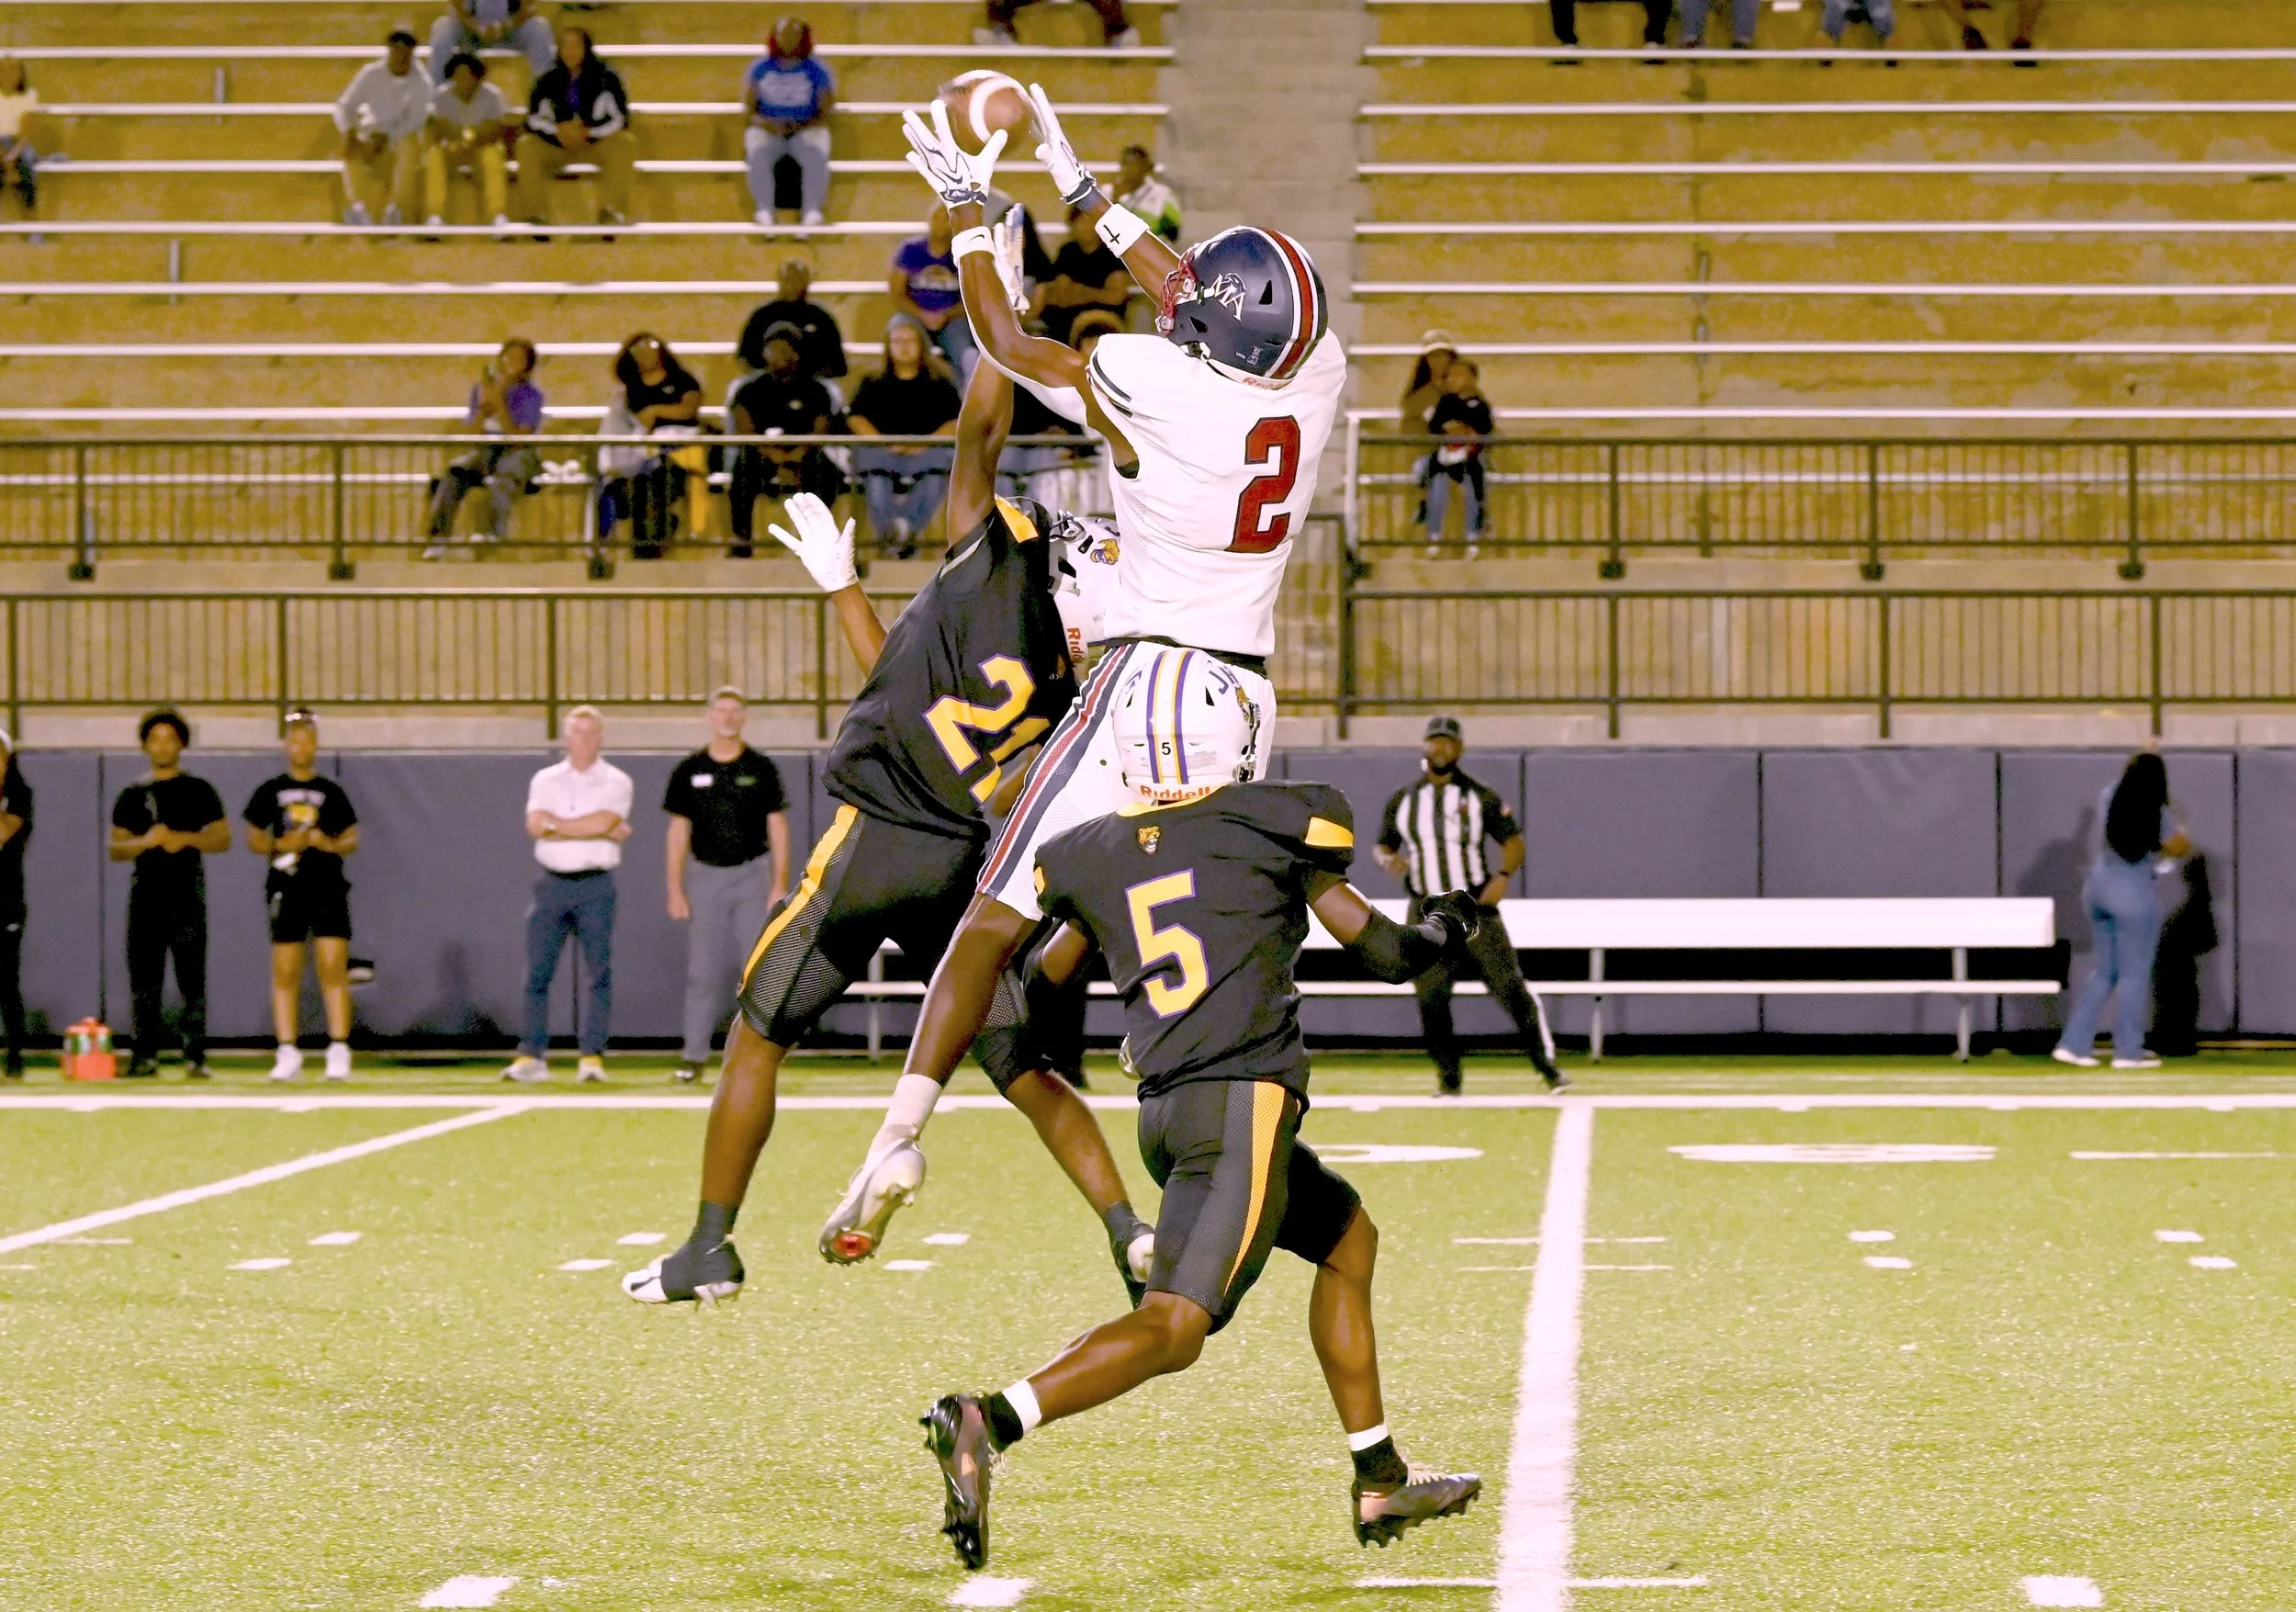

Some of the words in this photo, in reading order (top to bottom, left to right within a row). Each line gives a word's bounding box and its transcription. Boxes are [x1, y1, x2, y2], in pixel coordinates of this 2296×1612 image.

[1224, 414, 1301, 554] 2
[1162, 742, 1172, 756] 5
[1140, 784, 1210, 801] Riddell
[1124, 867, 1212, 1020] 5
